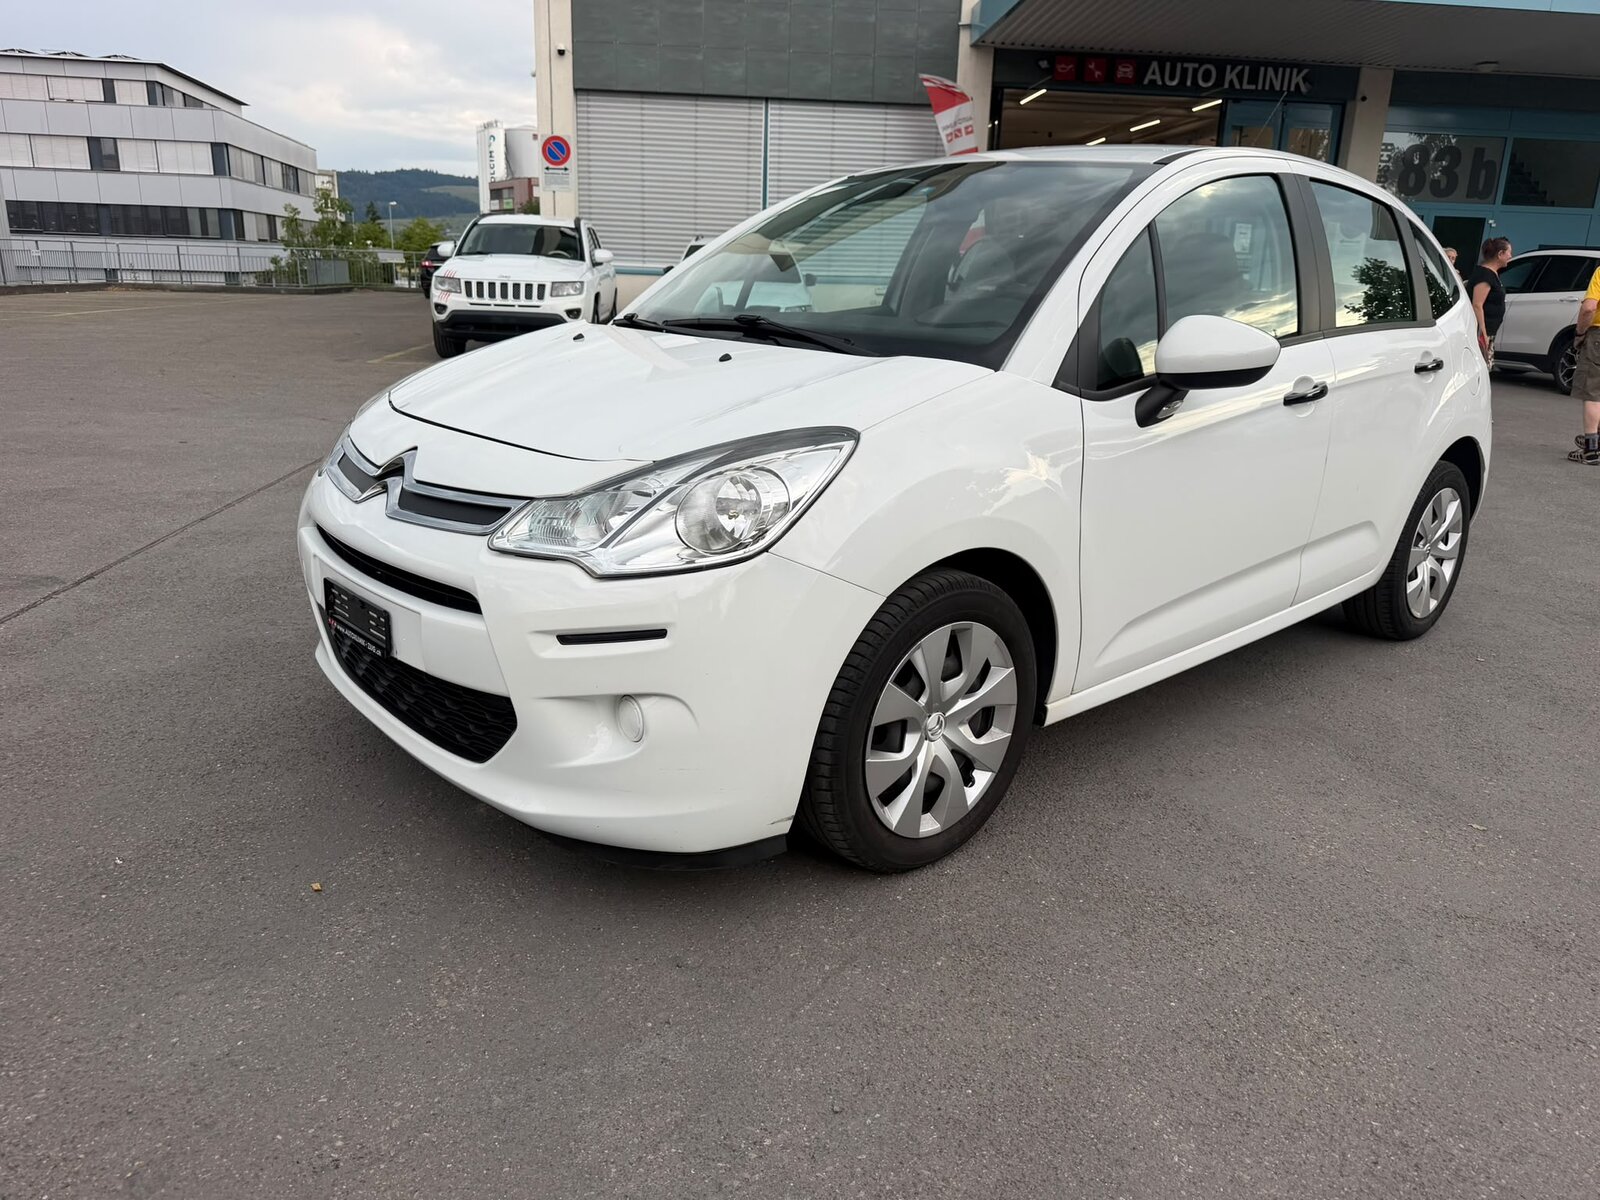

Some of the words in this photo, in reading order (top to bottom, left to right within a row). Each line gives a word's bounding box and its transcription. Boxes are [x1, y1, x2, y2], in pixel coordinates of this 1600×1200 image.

[1143, 60, 1217, 88] AUTO
[1223, 64, 1310, 94] KLINIK
[1397, 143, 1462, 198] 83
[1465, 147, 1498, 200] b
